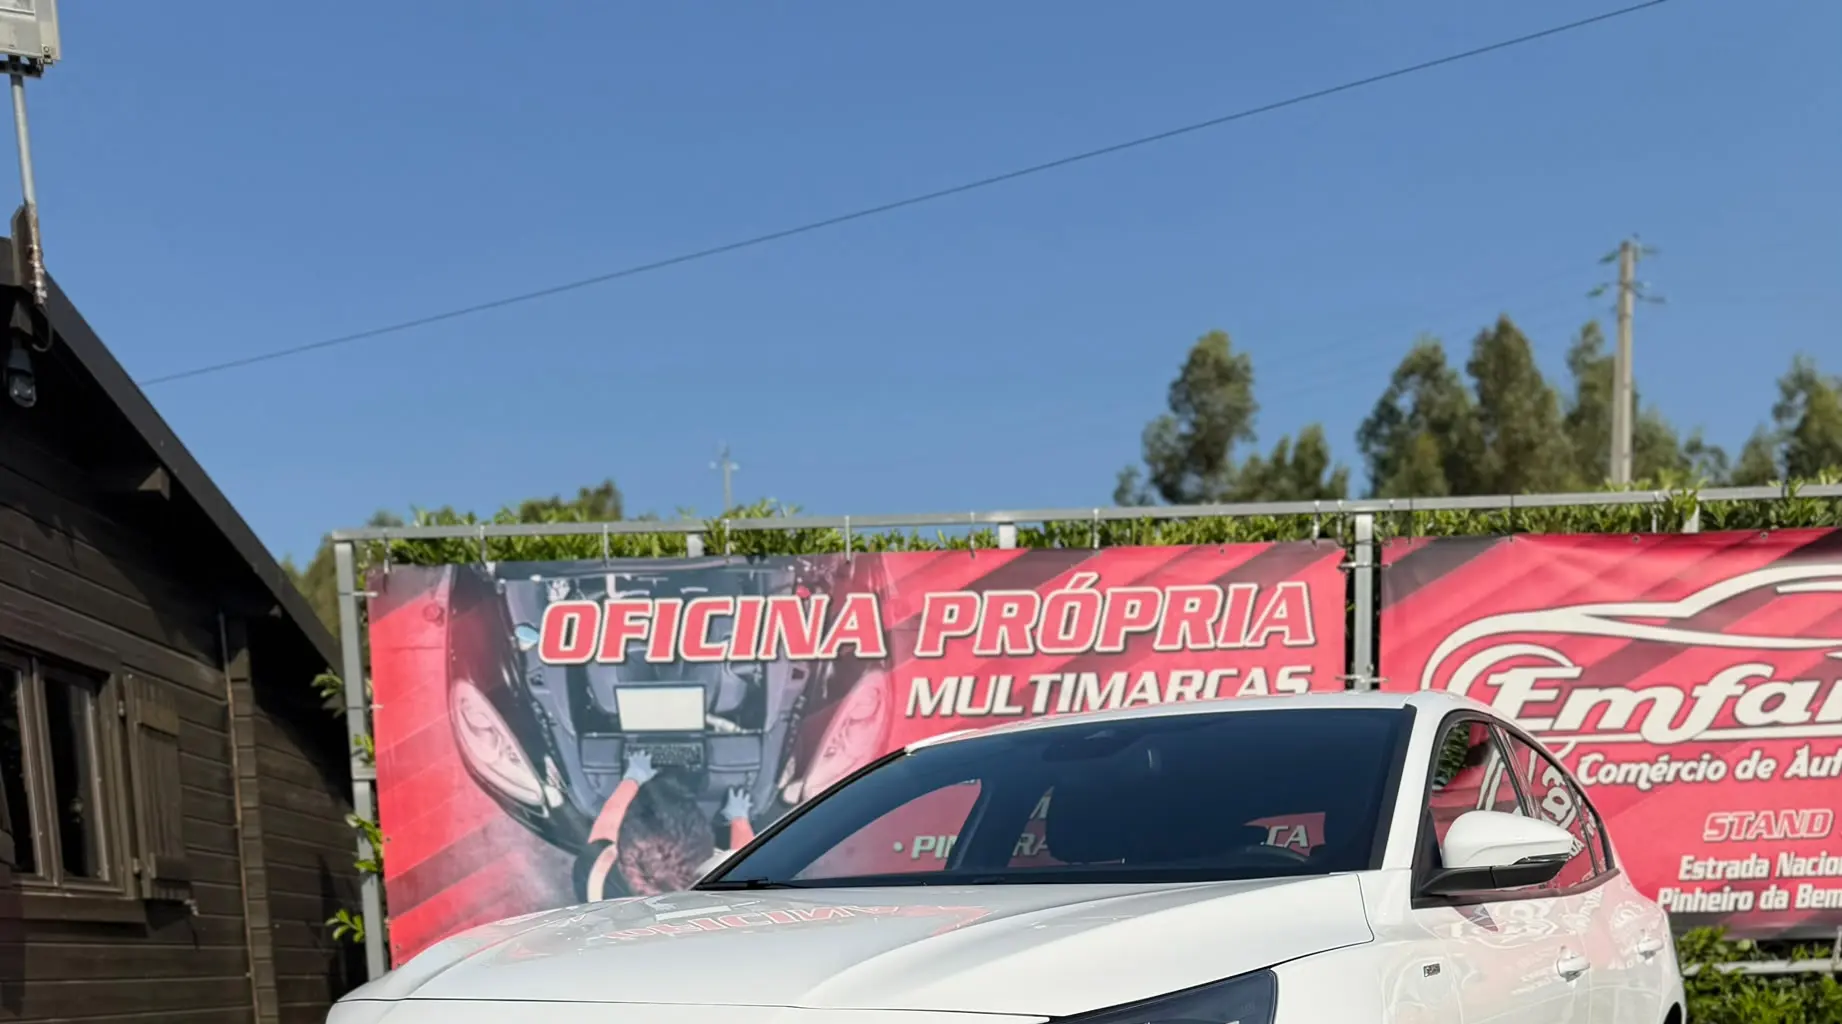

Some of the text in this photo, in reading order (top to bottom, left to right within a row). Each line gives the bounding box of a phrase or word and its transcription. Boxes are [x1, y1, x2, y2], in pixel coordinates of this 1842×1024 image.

[538, 572, 1316, 665] OFICINA PRÓPRIA
[905, 665, 1313, 716] MULTIMARCAS
[1577, 753, 1727, 790] Comércio
[1735, 748, 1778, 780] de
[1702, 808, 1833, 842] STAND
[1678, 853, 1770, 880] Estrada
[1657, 886, 1754, 912] Pinheiro
[1759, 884, 1789, 909] da
